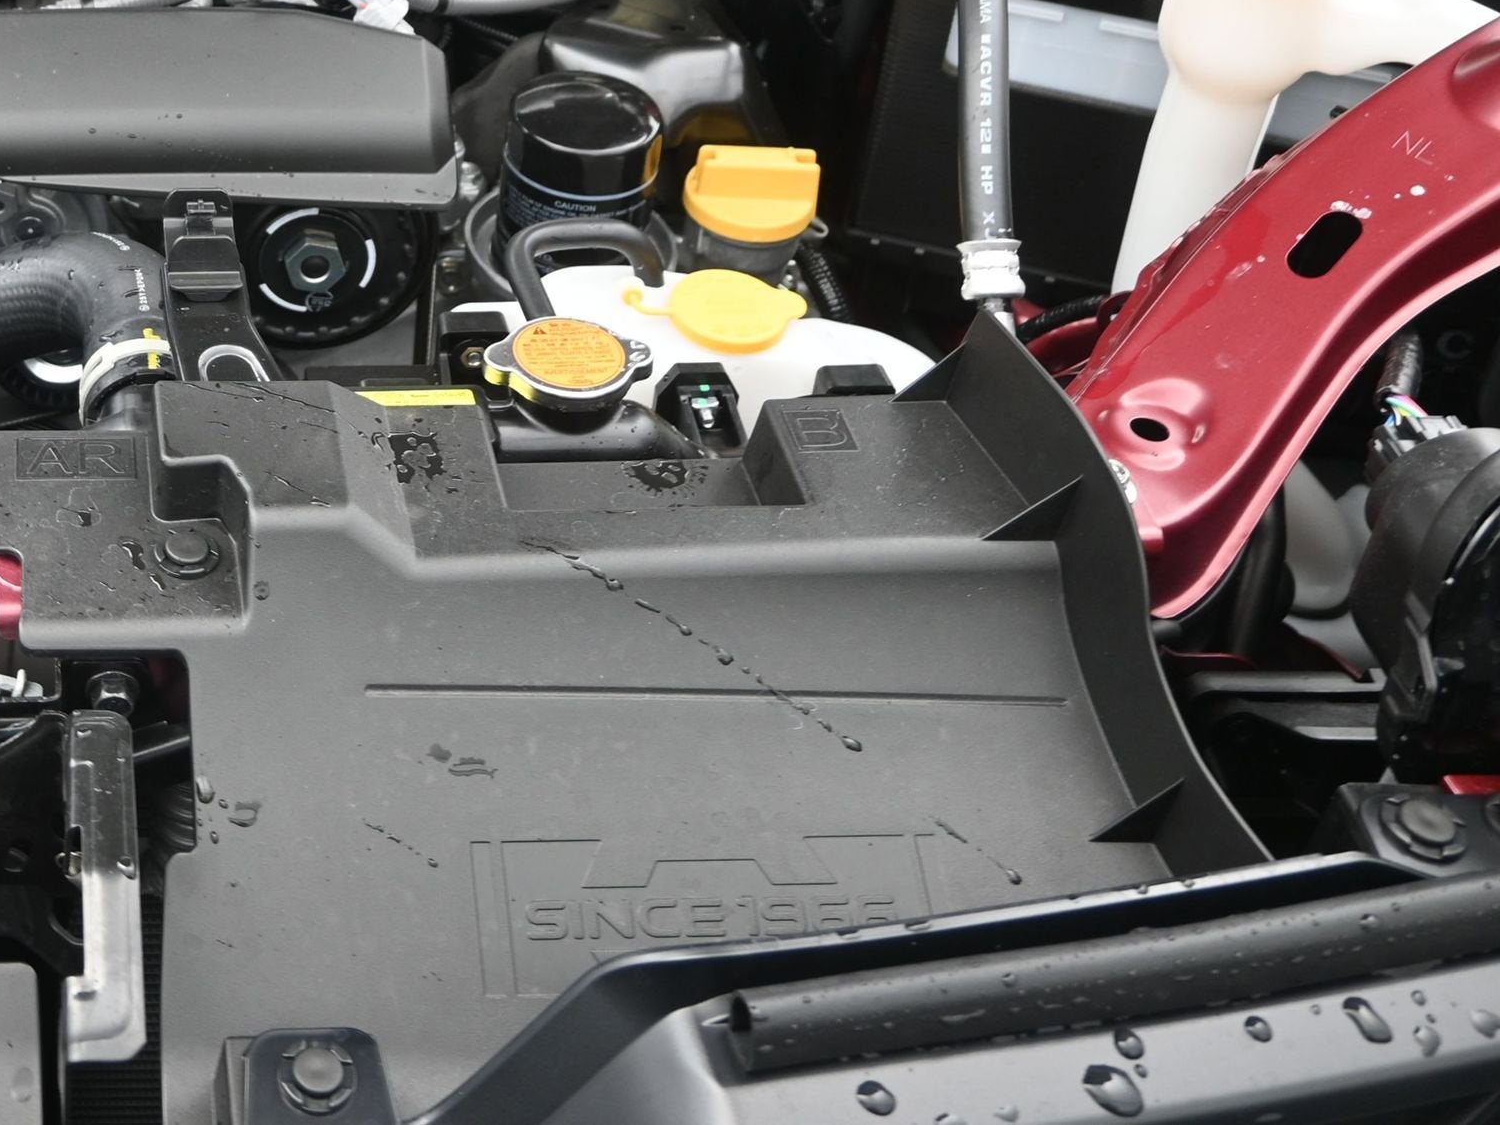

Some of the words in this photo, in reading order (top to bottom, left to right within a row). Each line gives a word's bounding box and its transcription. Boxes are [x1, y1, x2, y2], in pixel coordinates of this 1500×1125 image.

[980, 165, 994, 195] HP
[553, 200, 597, 212] CAUTION
[26, 440, 125, 474] AR
[526, 898, 728, 940] SINCE
